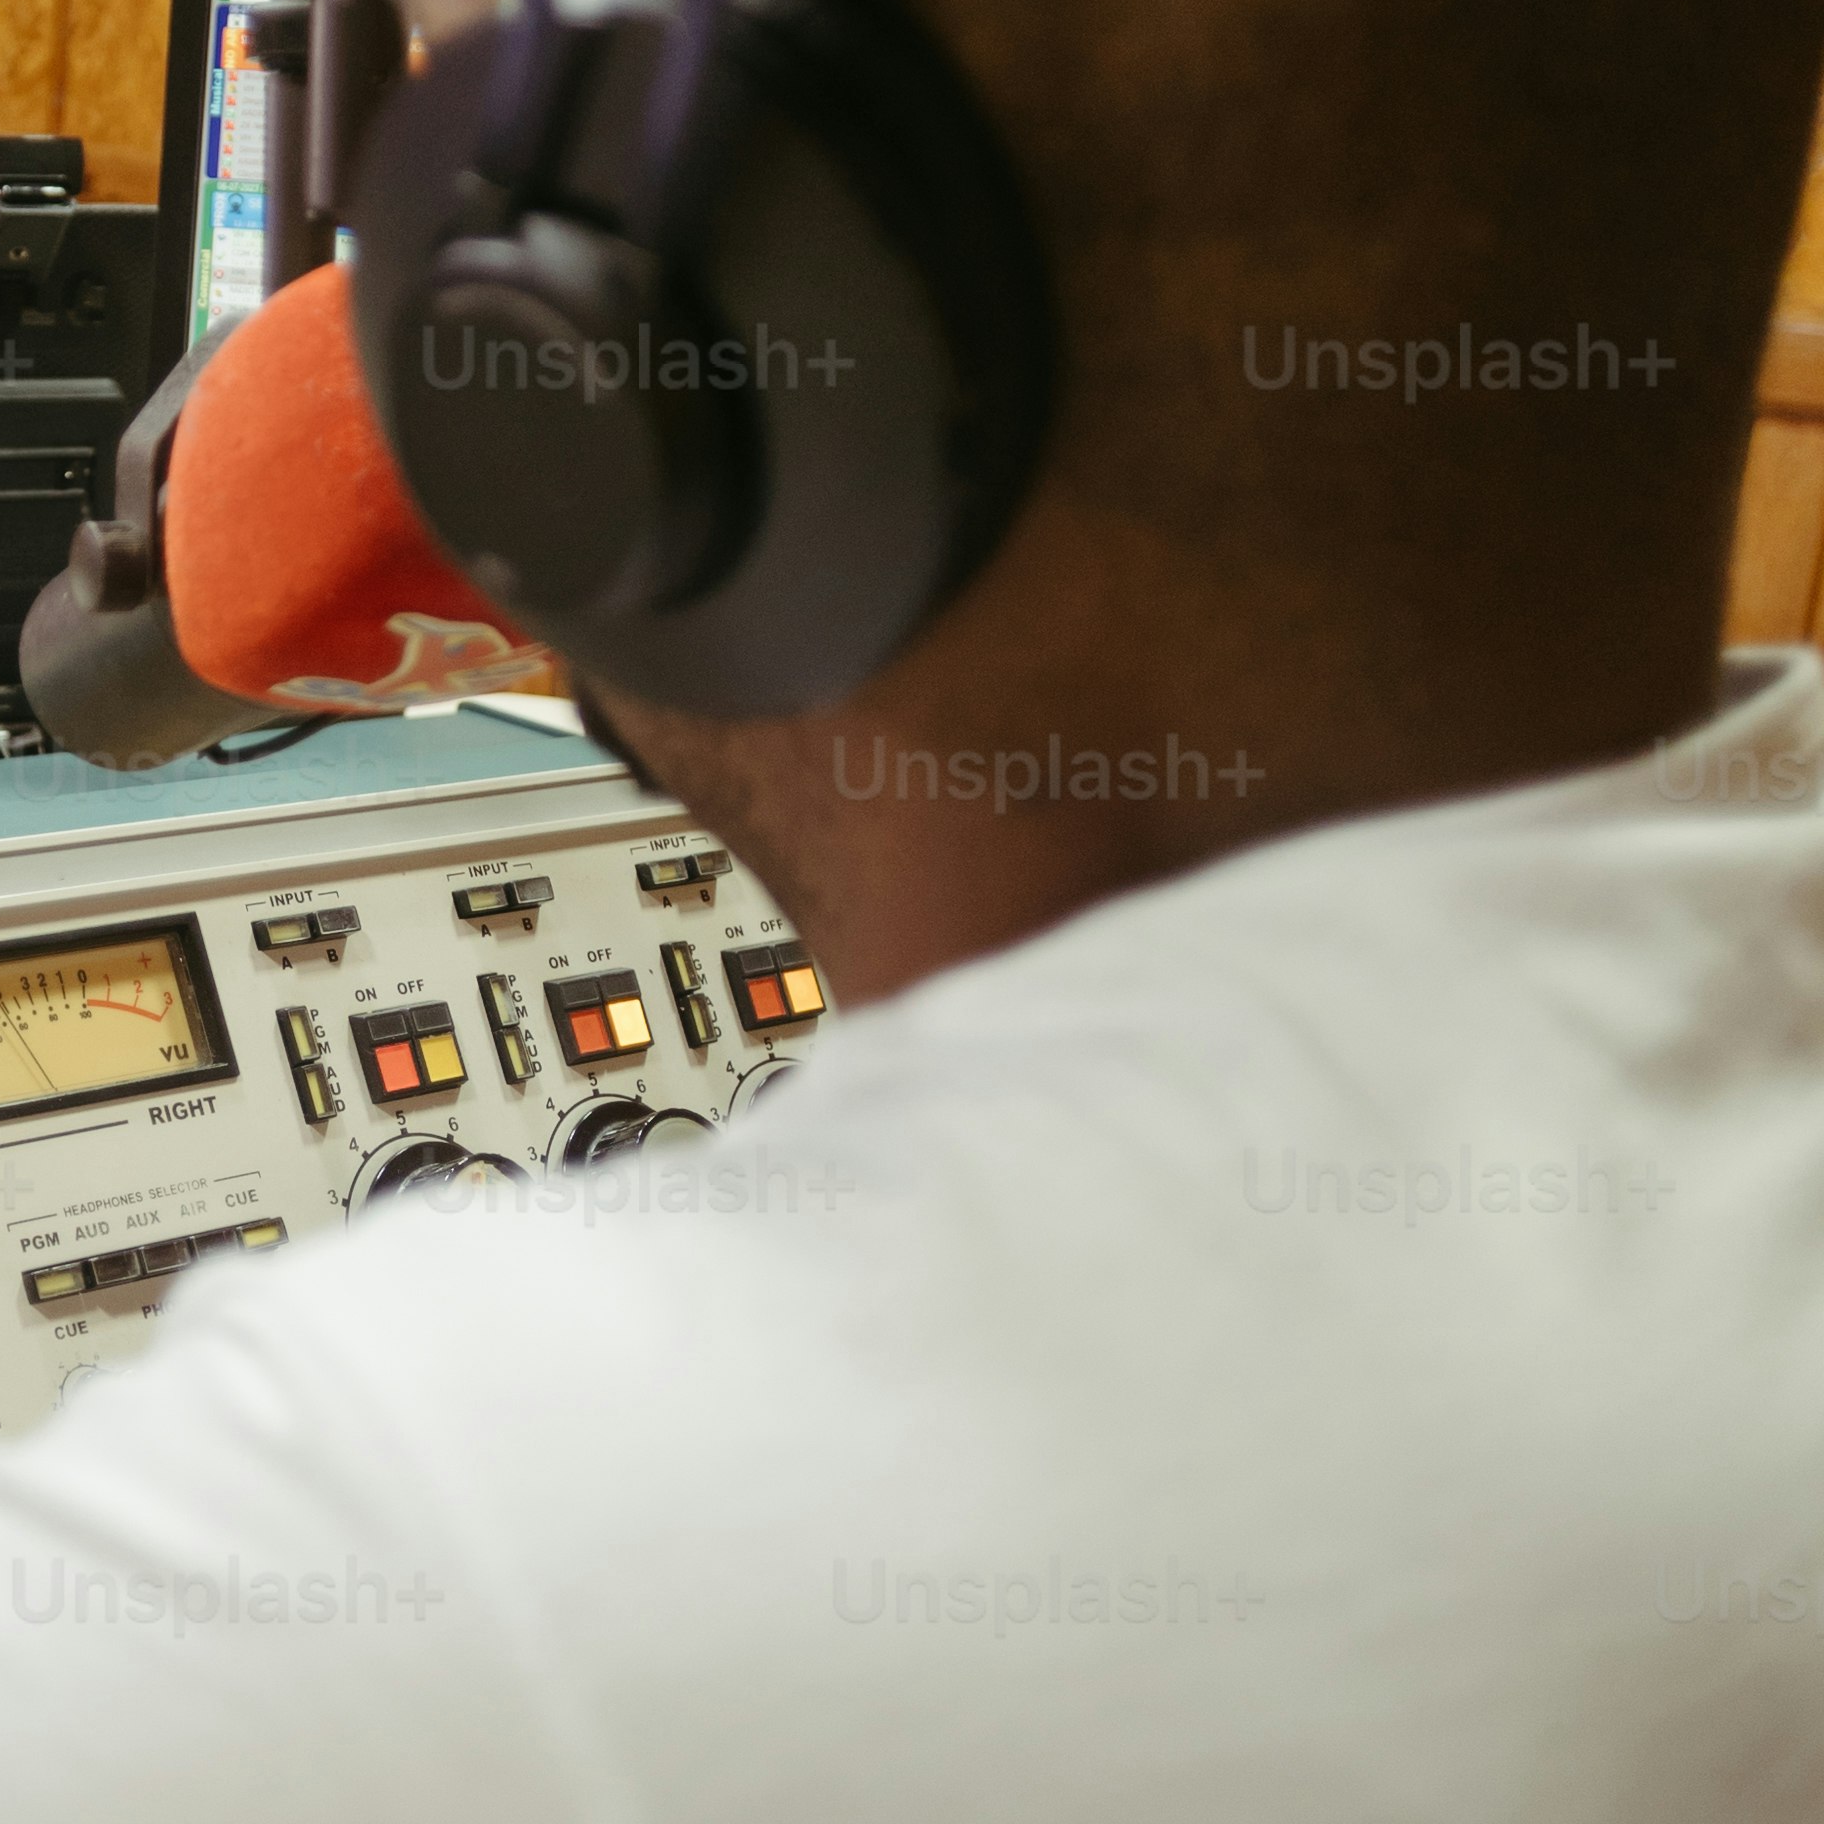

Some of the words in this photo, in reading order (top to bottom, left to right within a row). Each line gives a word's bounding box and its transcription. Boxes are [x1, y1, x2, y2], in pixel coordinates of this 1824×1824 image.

[648, 835, 688, 854] INPUT
[467, 861, 510, 880] INPUT
[269, 890, 314, 909] INPUT
[659, 896, 673, 909] A
[699, 890, 712, 902] B
[479, 925, 493, 939] A
[521, 919, 534, 932] B
[725, 926, 745, 939] ON
[759, 919, 783, 933] OFF
[280, 957, 294, 970] A
[326, 950, 340, 964] B
[548, 954, 571, 970] ON
[586, 946, 613, 963] OFF
[354, 987, 378, 1003] ON
[396, 978, 426, 995] OFF
[586, 1072, 599, 1088] 5
[635, 1079, 648, 1094] 6
[148, 1096, 217, 1125] RIGHT
[545, 1097, 557, 1112] 4
[395, 1110, 408, 1127] 5
[446, 1116, 460, 1133] 6
[347, 1136, 361, 1153] 4
[526, 1146, 539, 1162] 3
[63, 1191, 144, 1218] HEADPHONES
[148, 1178, 209, 1201] SELECTOR
[326, 1189, 340, 1206] 3
[20, 1232, 61, 1254] PGM
[73, 1220, 111, 1241] AUD
[125, 1209, 162, 1230] AUX
[224, 1189, 260, 1209] CUE
[54, 1320, 90, 1342] CUE
